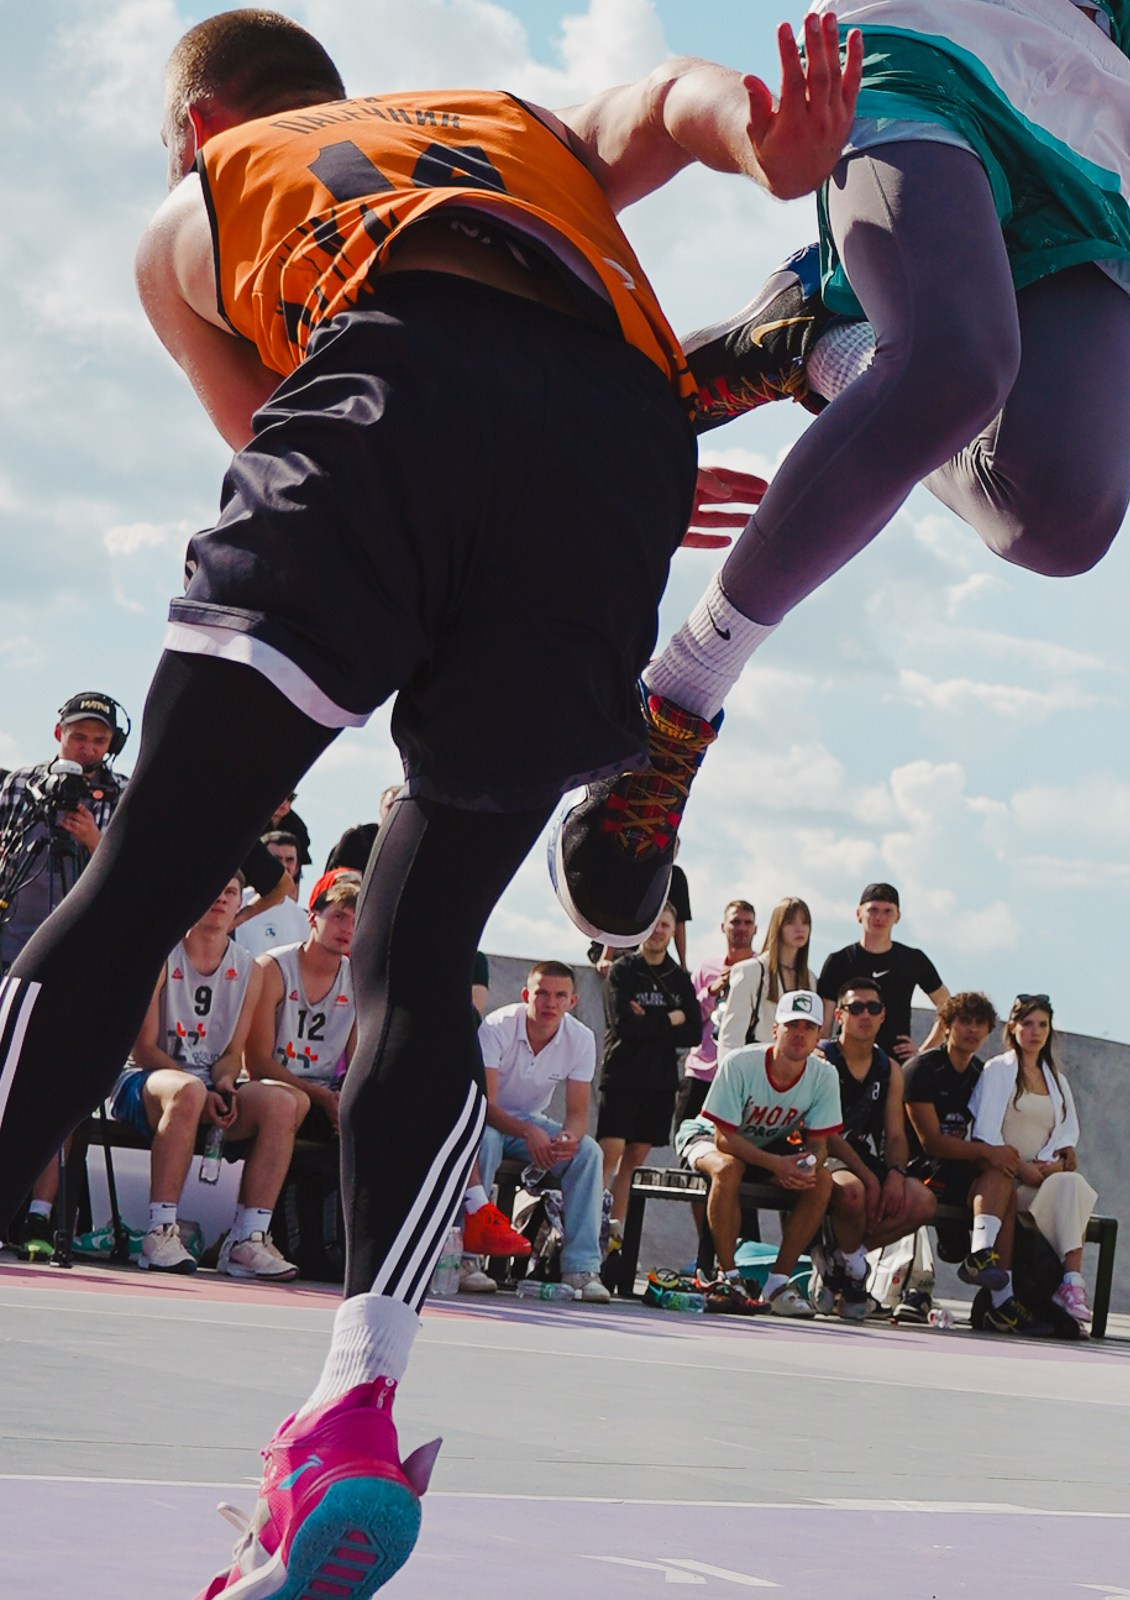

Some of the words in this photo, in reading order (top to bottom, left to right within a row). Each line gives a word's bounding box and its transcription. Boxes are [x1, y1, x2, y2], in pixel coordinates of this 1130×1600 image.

[271, 105, 462, 135] ПАСЕЧНИК
[194, 985, 213, 1017] 9
[297, 1009, 327, 1042] 12
